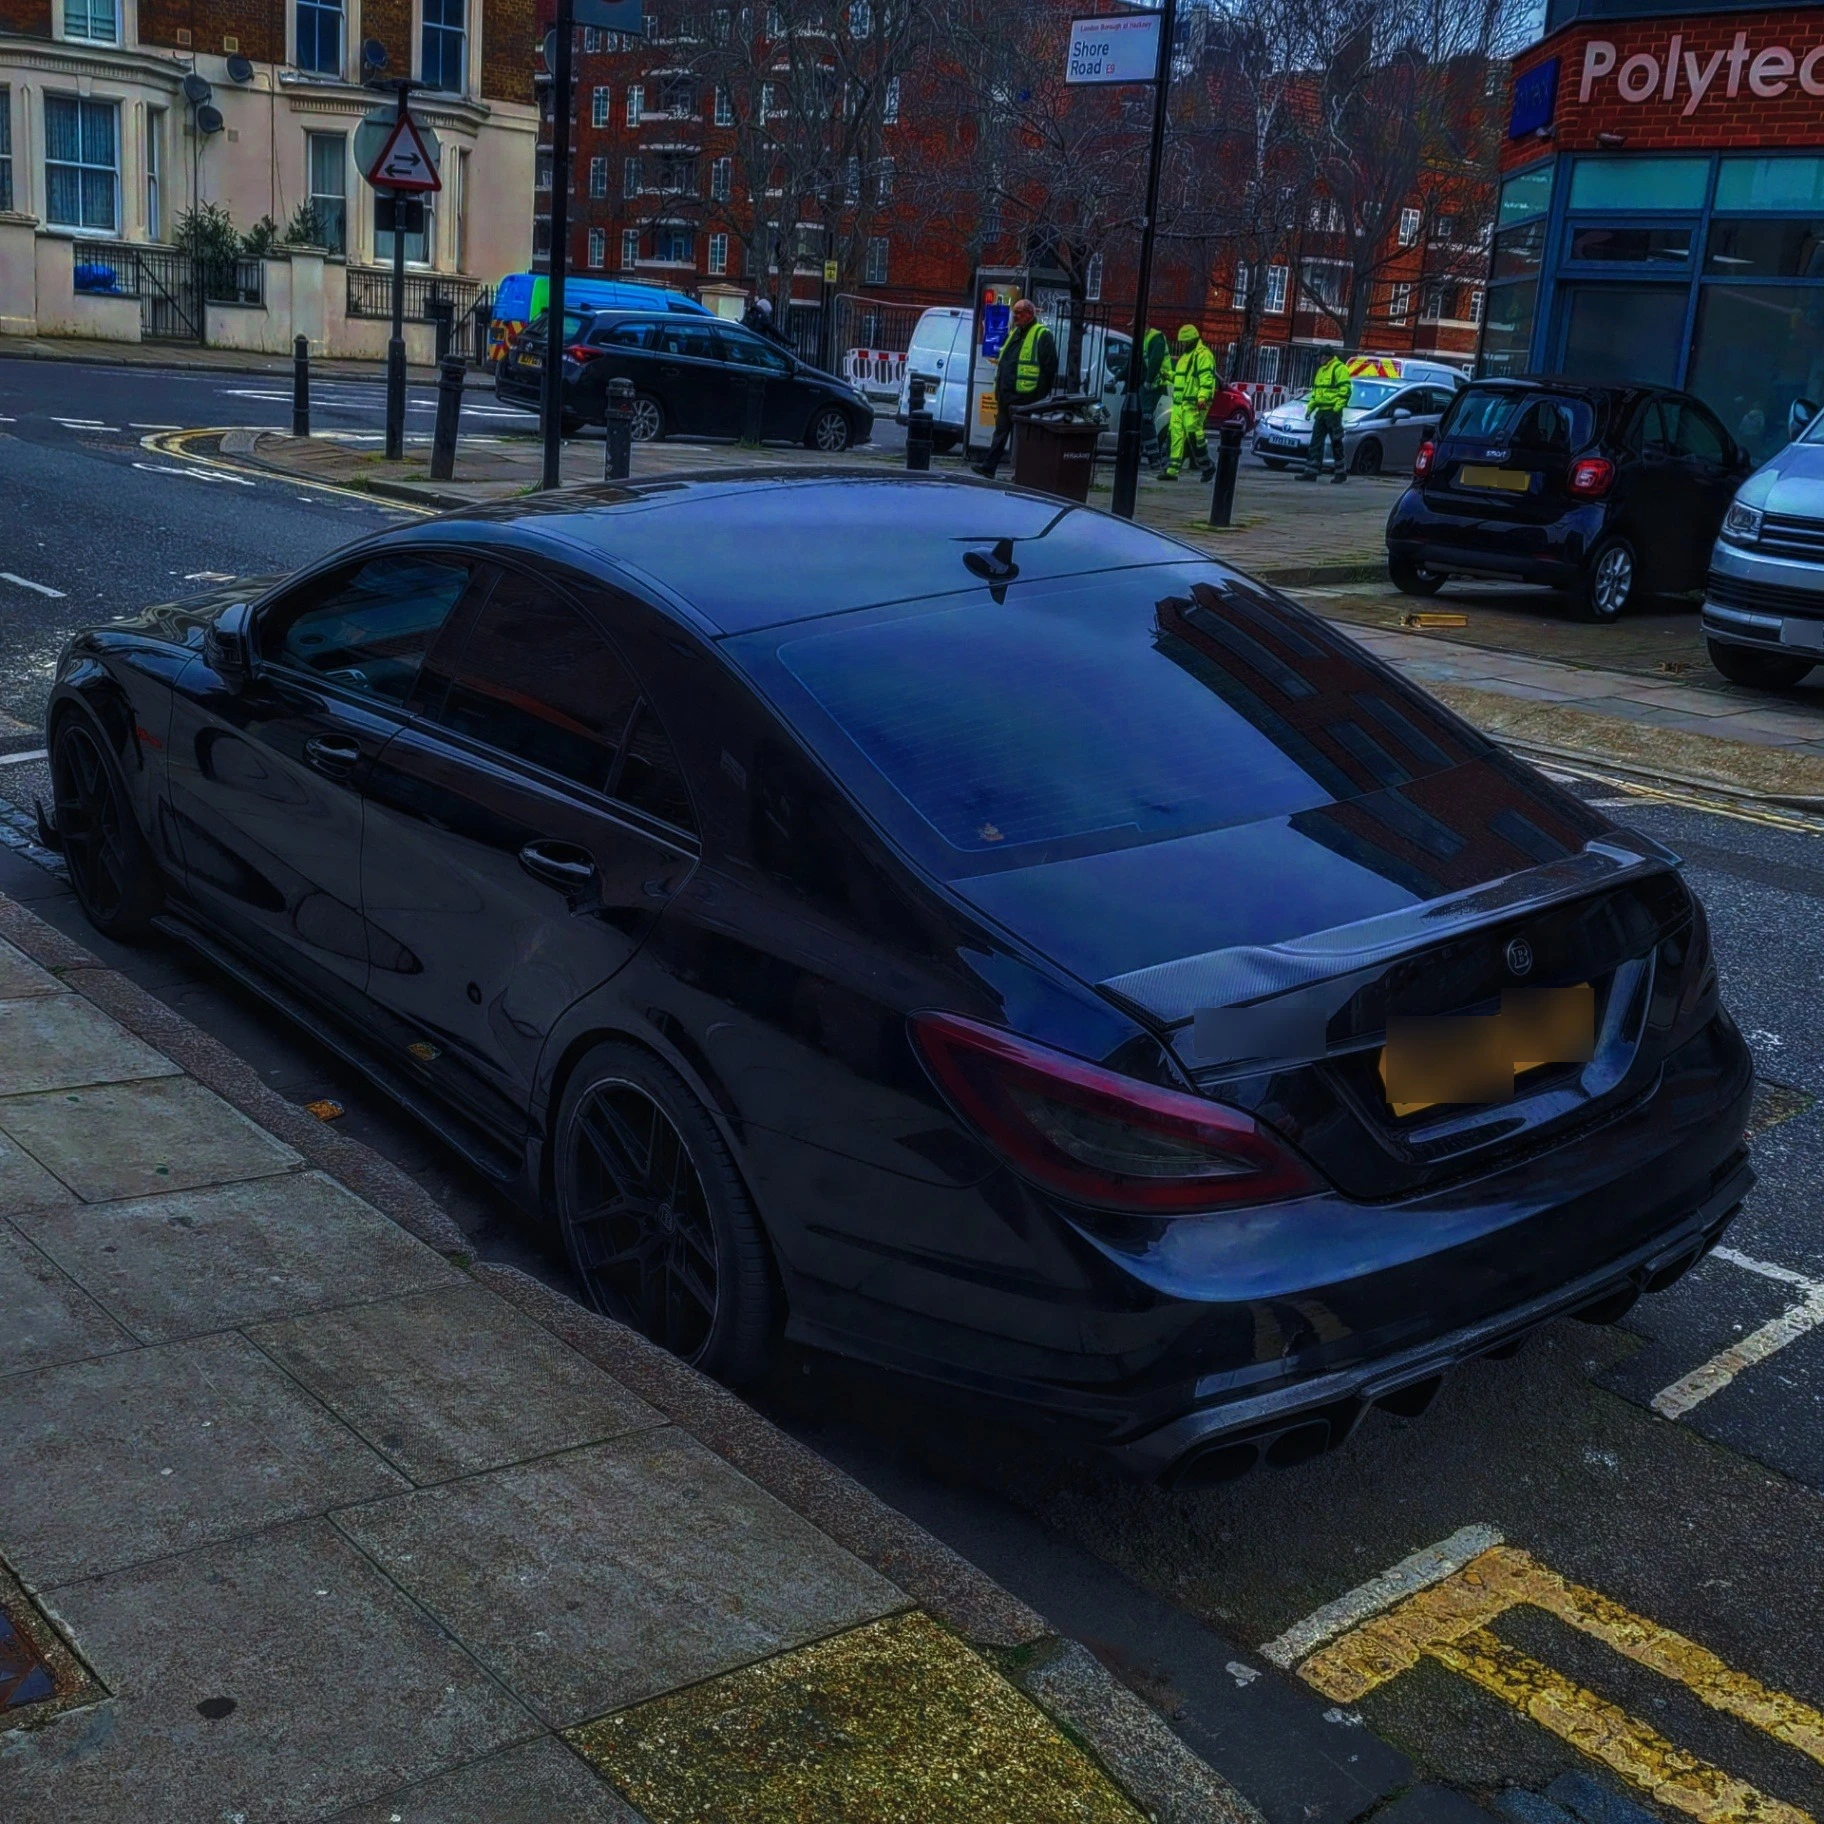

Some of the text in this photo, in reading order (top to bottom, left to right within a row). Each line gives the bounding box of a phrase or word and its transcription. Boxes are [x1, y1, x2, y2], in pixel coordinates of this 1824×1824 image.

[1080, 24, 1099, 32] London
[1100, 23, 1121, 32] Borough
[1129, 21, 1152, 31] Hackney
[1073, 41, 1110, 57] Shore
[1070, 58, 1116, 75] Road E9
